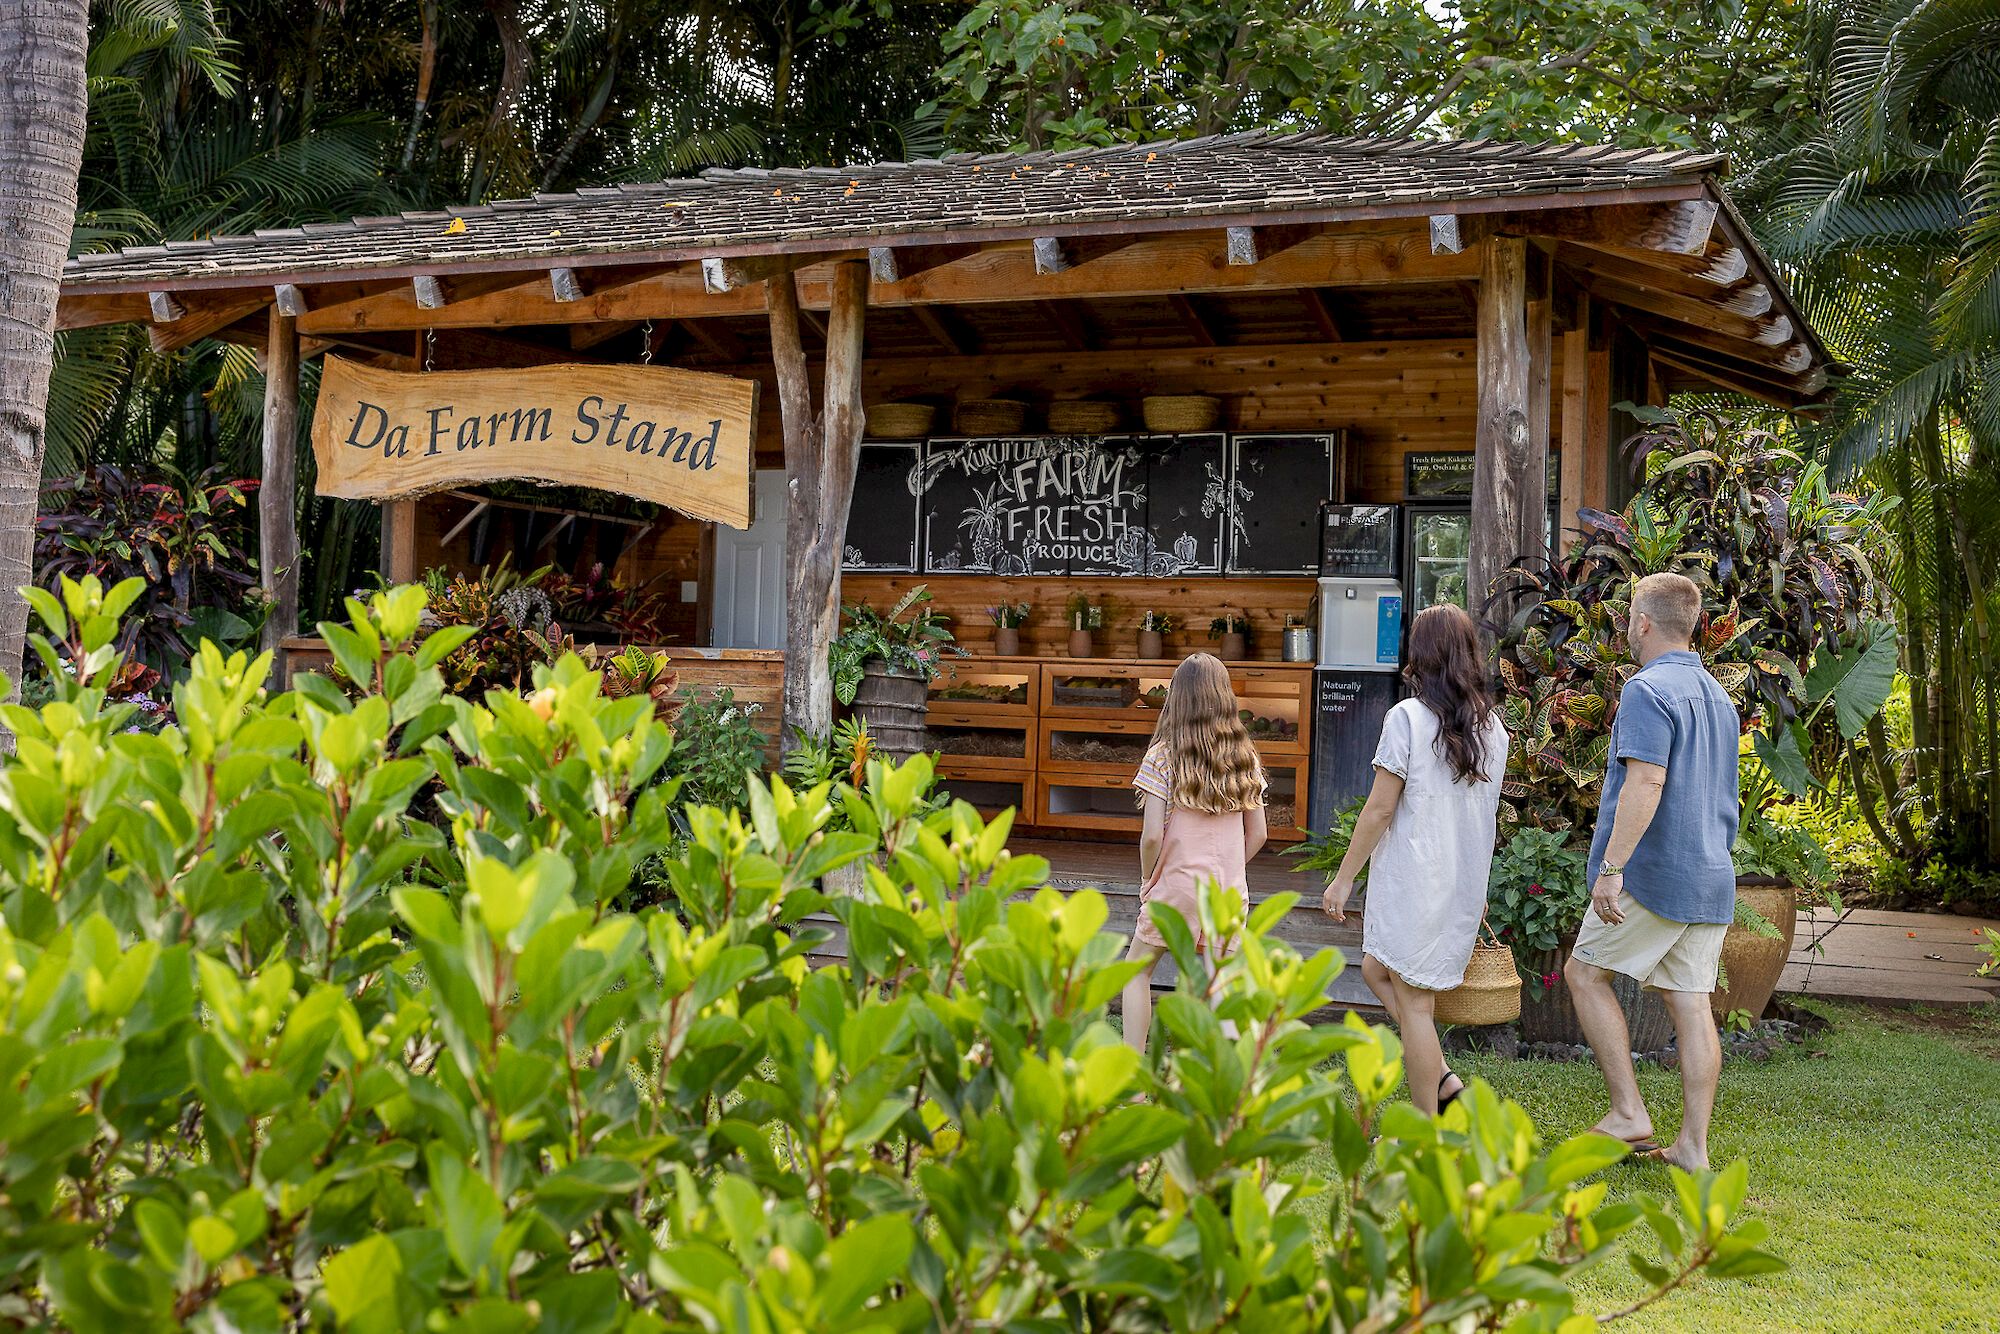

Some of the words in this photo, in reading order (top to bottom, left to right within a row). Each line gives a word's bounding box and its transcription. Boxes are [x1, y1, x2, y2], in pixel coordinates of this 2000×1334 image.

[344, 400, 410, 459] Da
[423, 404, 552, 457] Farm
[571, 395, 723, 471] Stand
[1432, 463, 1459, 471] Orchard
[1012, 450, 1126, 508] FARM
[1007, 505, 1128, 542] FRESH
[1026, 544, 1114, 562] PRODUCE
[1322, 681, 1361, 692] Naturally
[1322, 692, 1355, 701] brilliant
[1321, 704, 1347, 712] water
